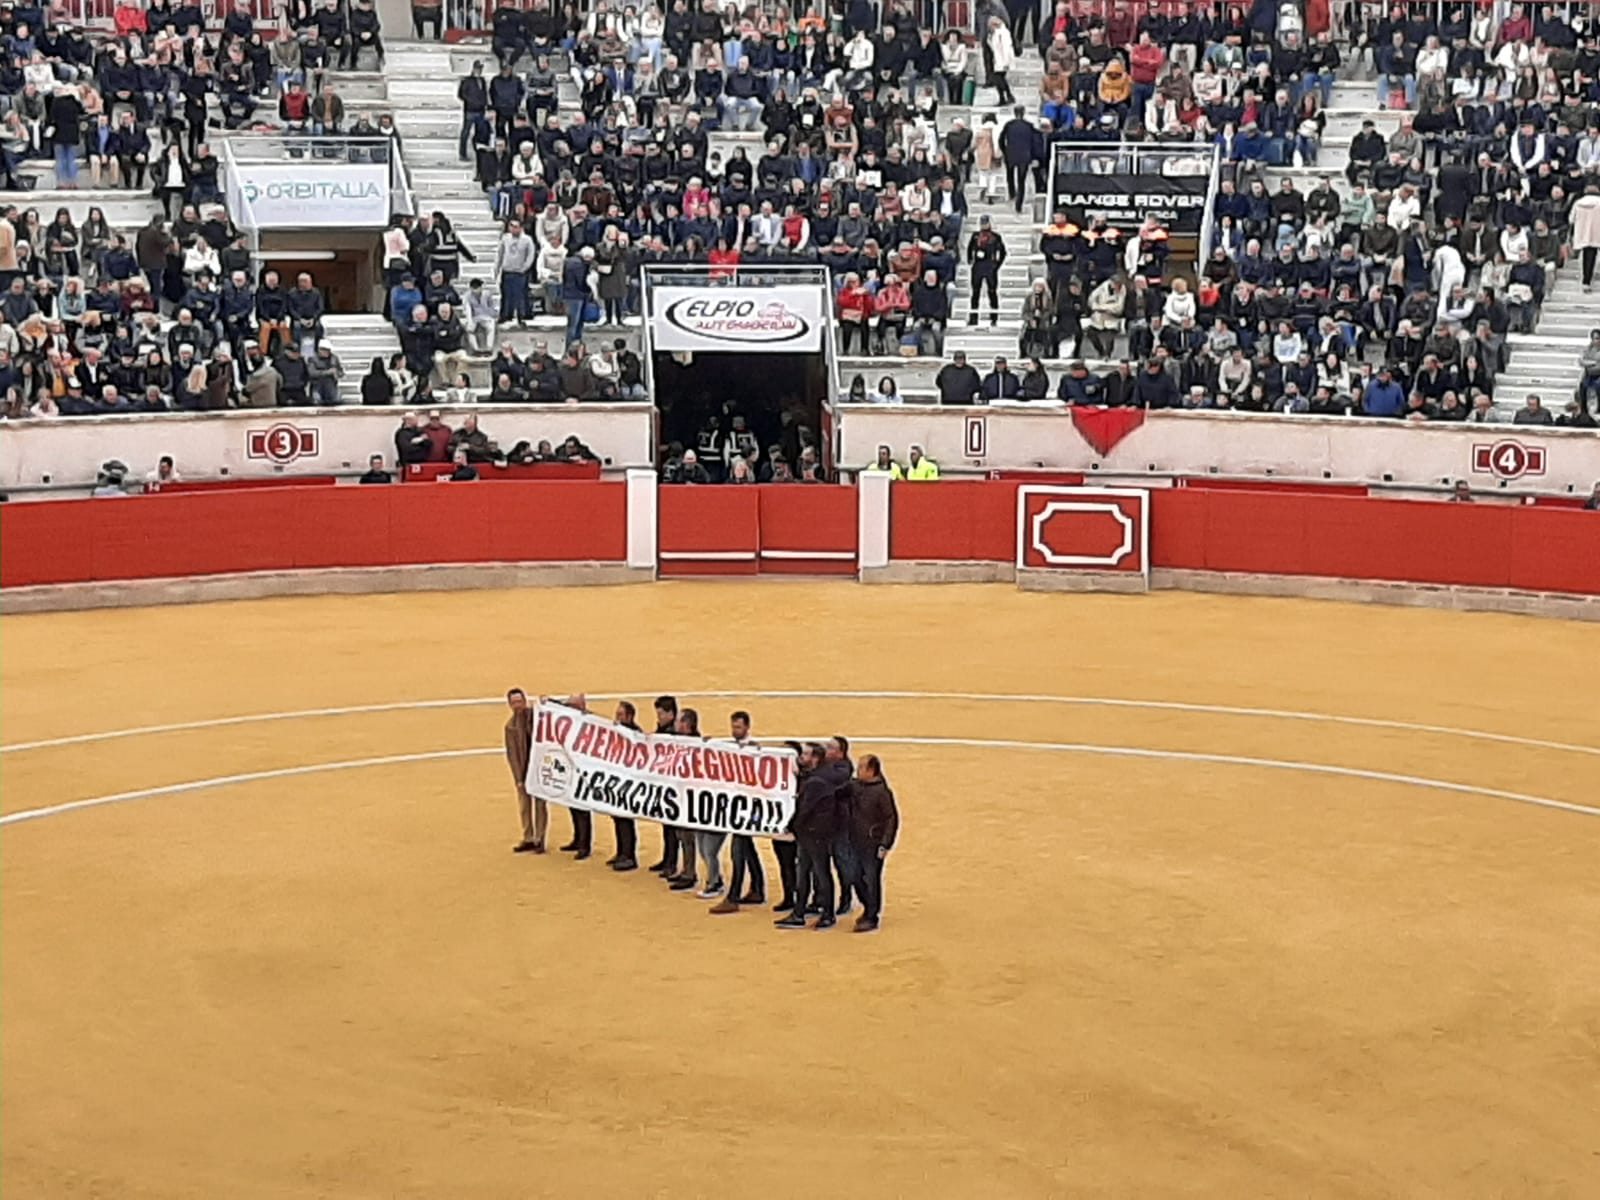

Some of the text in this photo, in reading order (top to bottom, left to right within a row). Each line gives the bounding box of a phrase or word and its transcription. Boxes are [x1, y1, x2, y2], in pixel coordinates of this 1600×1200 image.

[267, 182, 380, 199] ORBITALIA
[1058, 194, 1204, 207] RANGE ROVER
[275, 431, 291, 455] 3
[1499, 448, 1516, 472] 4
[536, 711, 573, 745] ¡LO
[572, 722, 650, 770] HEMOS
[686, 788, 783, 834] LORCA!!
